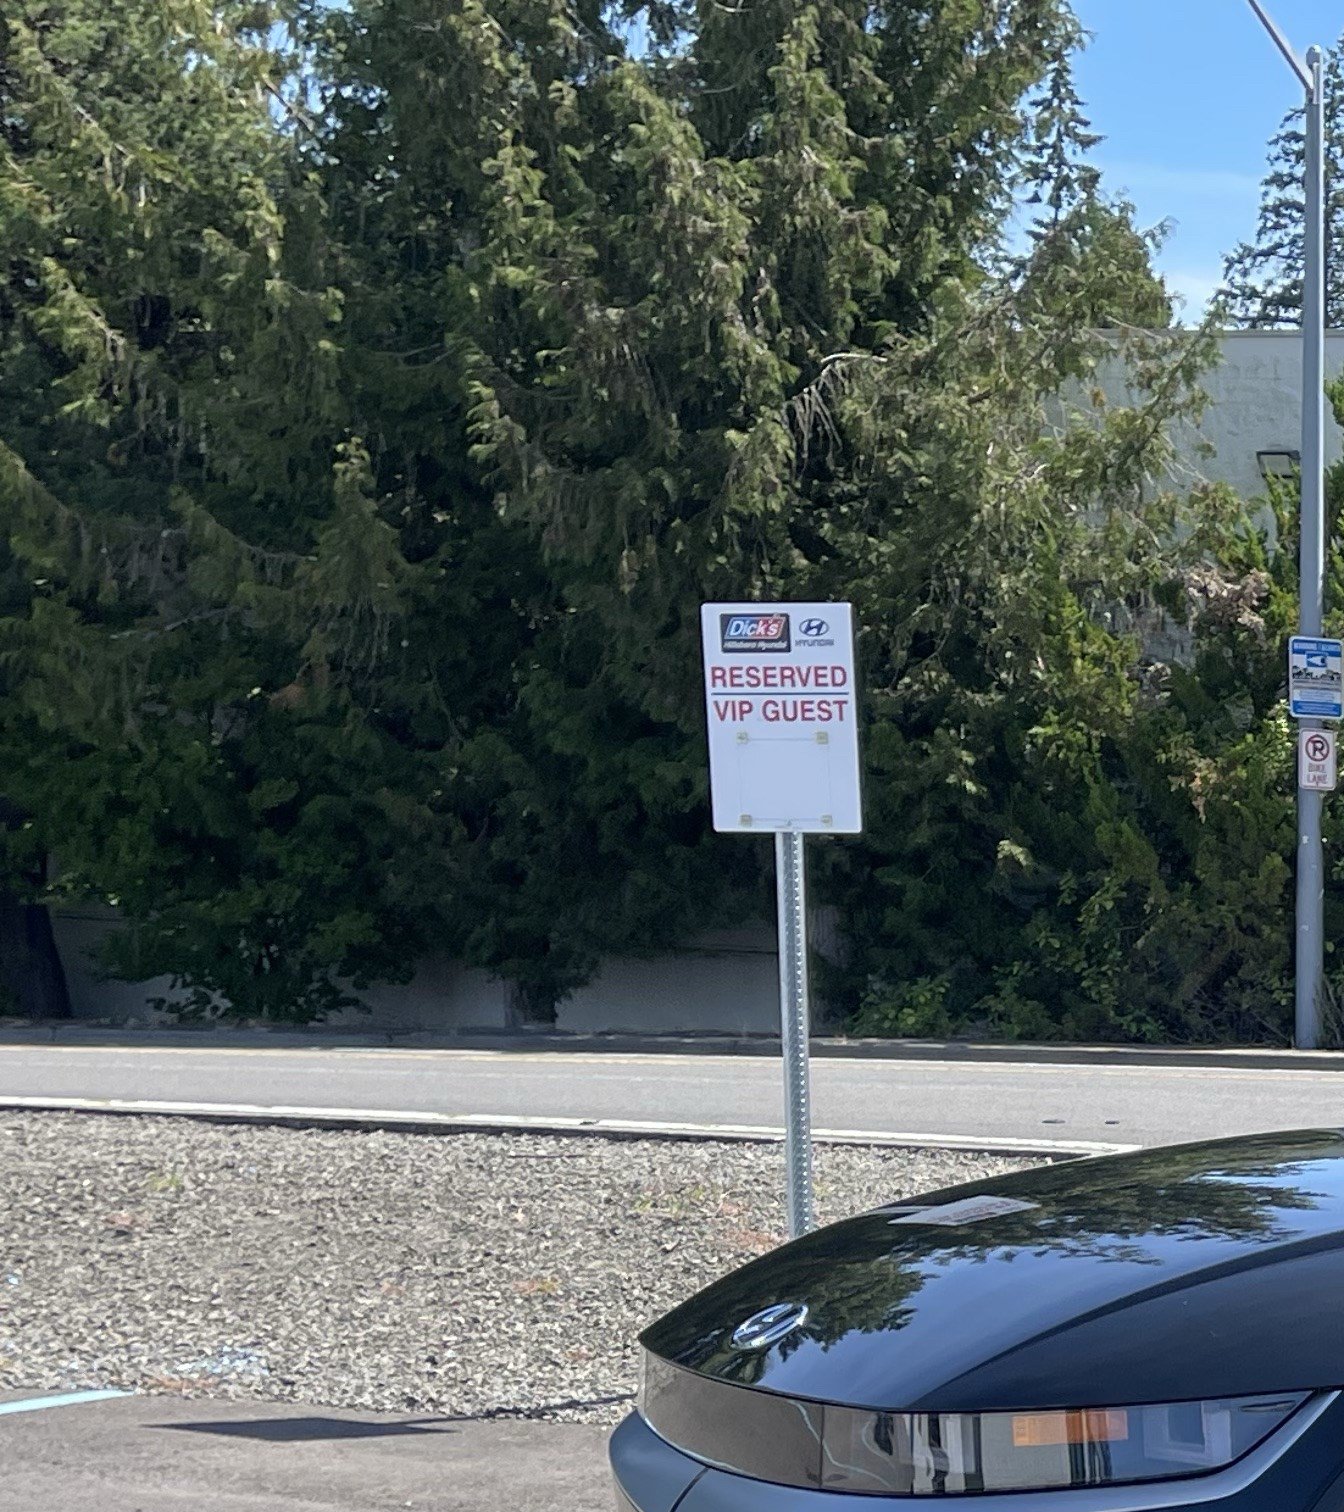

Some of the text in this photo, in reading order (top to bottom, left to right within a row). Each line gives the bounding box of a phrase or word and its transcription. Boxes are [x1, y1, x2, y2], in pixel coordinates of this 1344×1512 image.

[729, 619, 779, 636] Dick's
[711, 666, 847, 688] RESERVED
[713, 699, 848, 722] VIP GUEST
